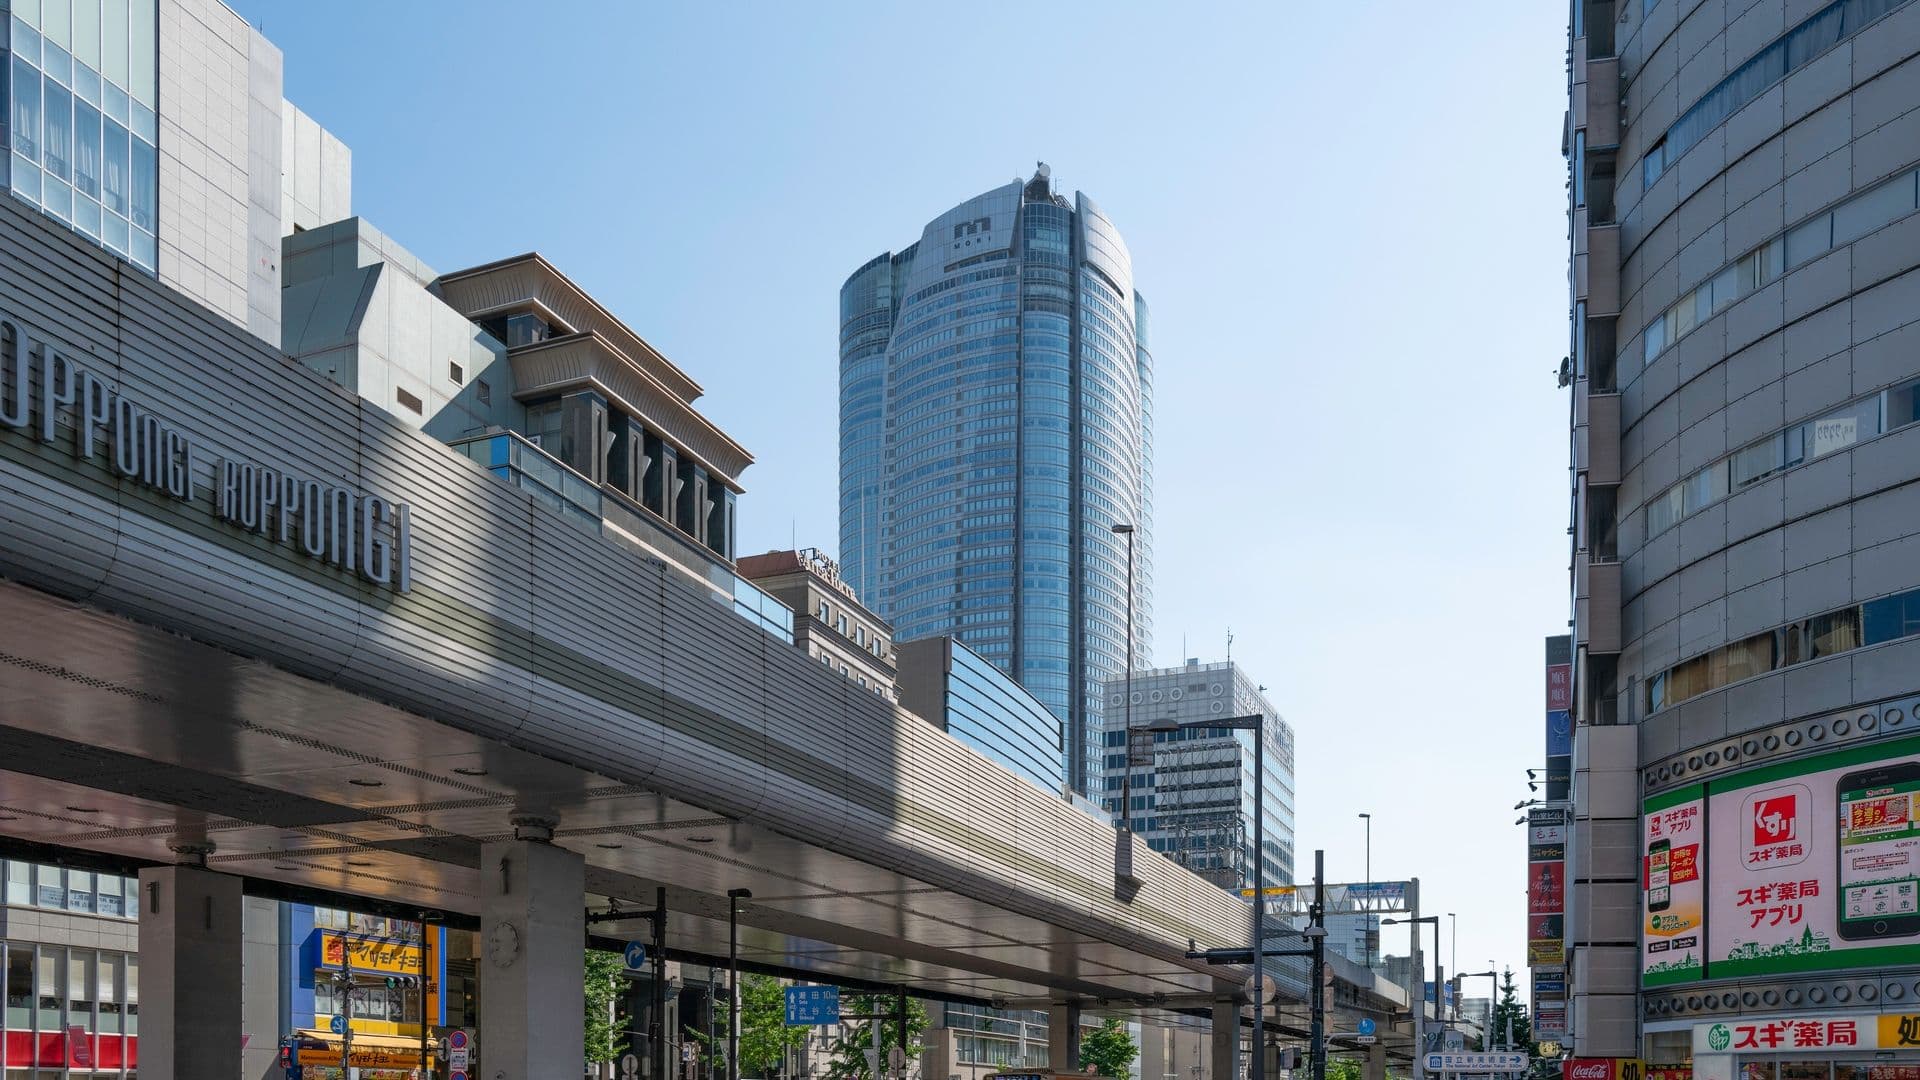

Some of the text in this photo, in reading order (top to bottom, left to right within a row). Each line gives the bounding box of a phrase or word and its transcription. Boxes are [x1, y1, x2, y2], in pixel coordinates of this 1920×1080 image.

[217, 457, 411, 594] ROPPONGI
[1664, 806, 1698, 824] スギ薬局
[1670, 820, 1691, 834] アプリ
[1671, 858, 1695, 870] クーポン
[1748, 844, 1803, 863] スギ薬局
[1737, 880, 1819, 906] スギ薬局
[1750, 904, 1803, 928] アプリ
[1734, 1020, 1857, 1049] スギ薬局
